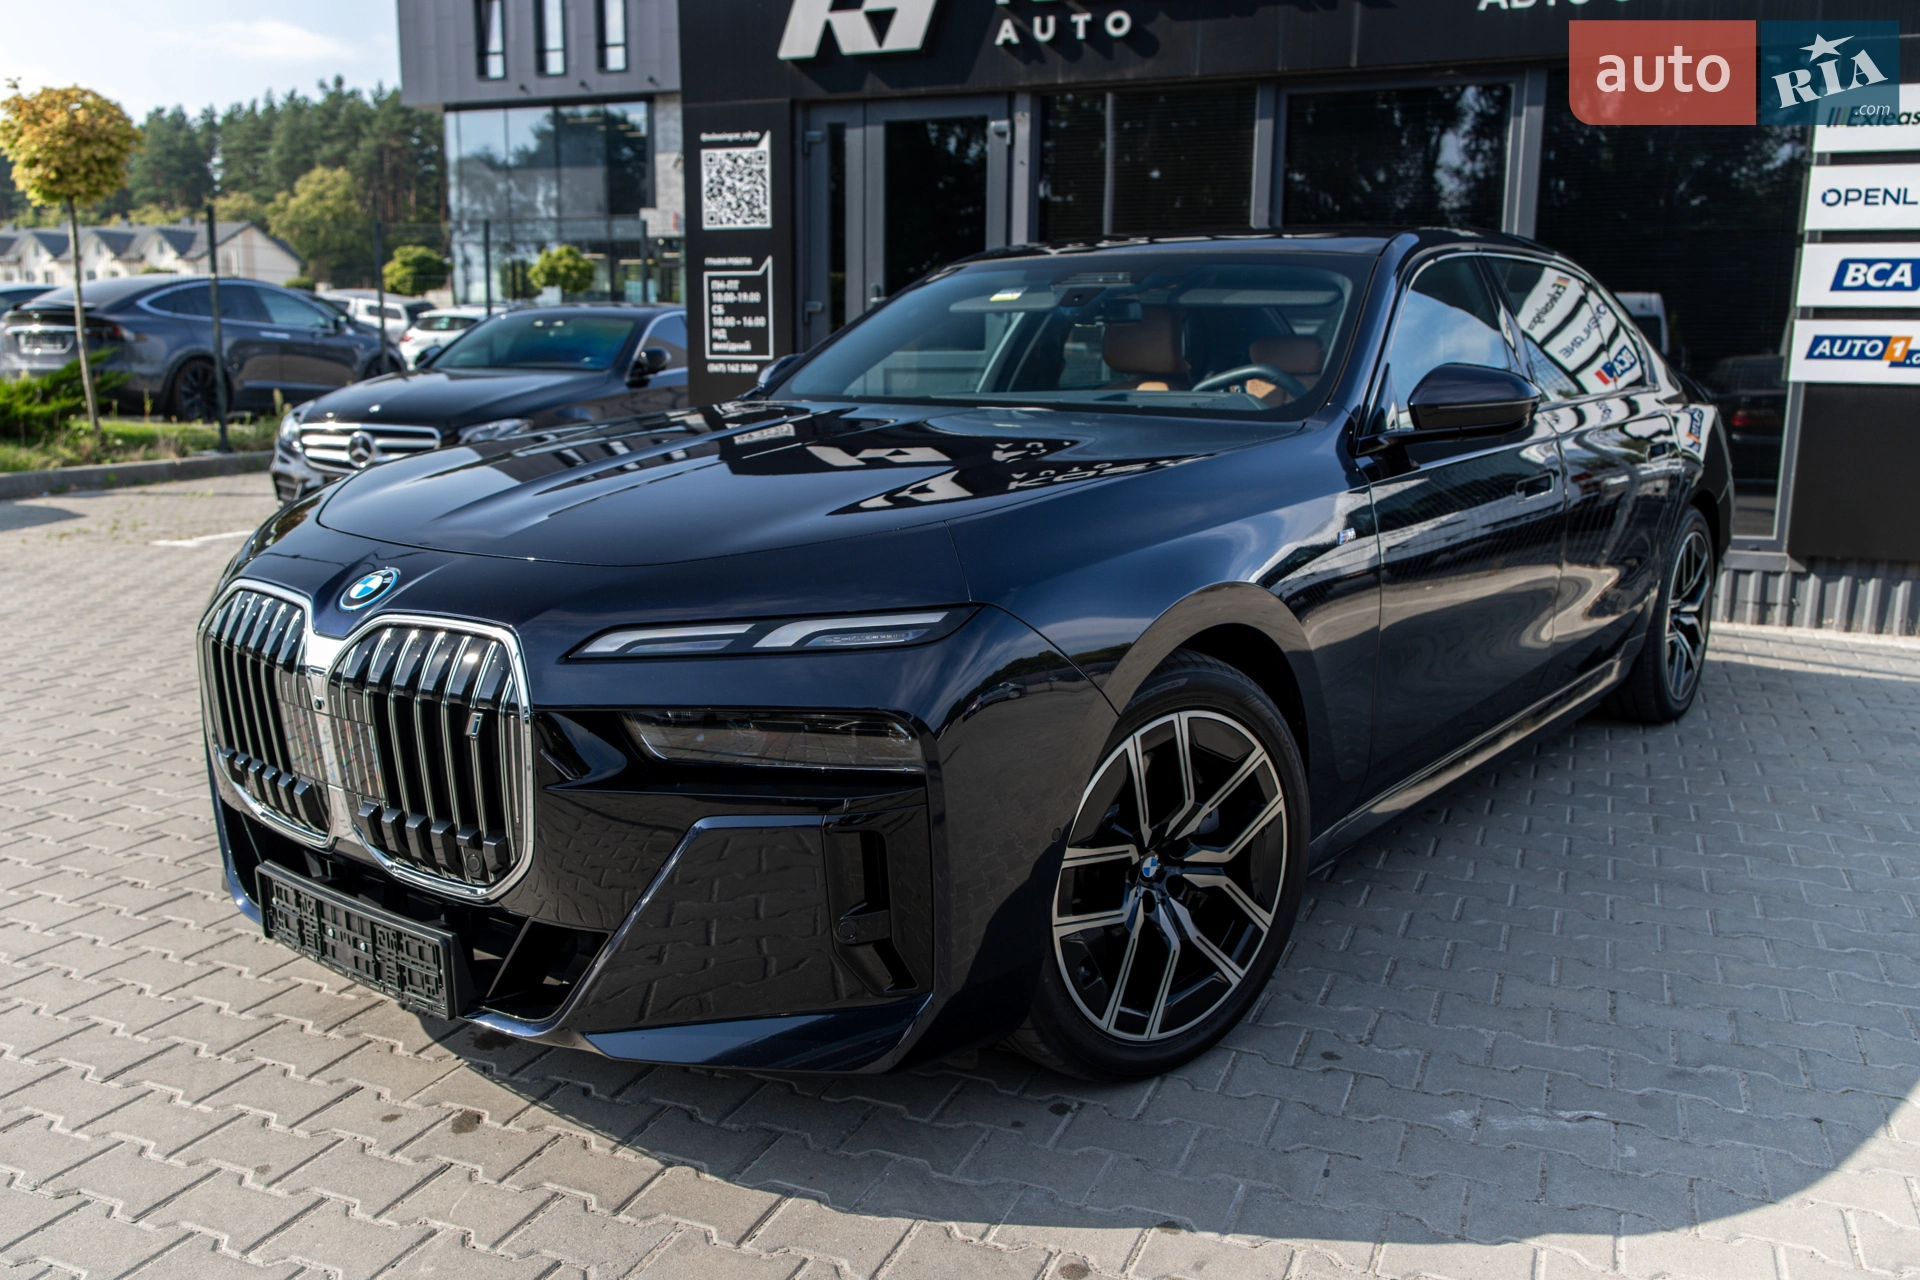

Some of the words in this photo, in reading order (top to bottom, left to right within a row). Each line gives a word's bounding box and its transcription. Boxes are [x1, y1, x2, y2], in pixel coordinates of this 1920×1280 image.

[995, 10, 1132, 46] AUTO
[1821, 187, 1919, 206] OPENL
[1842, 262, 1913, 288] BCA
